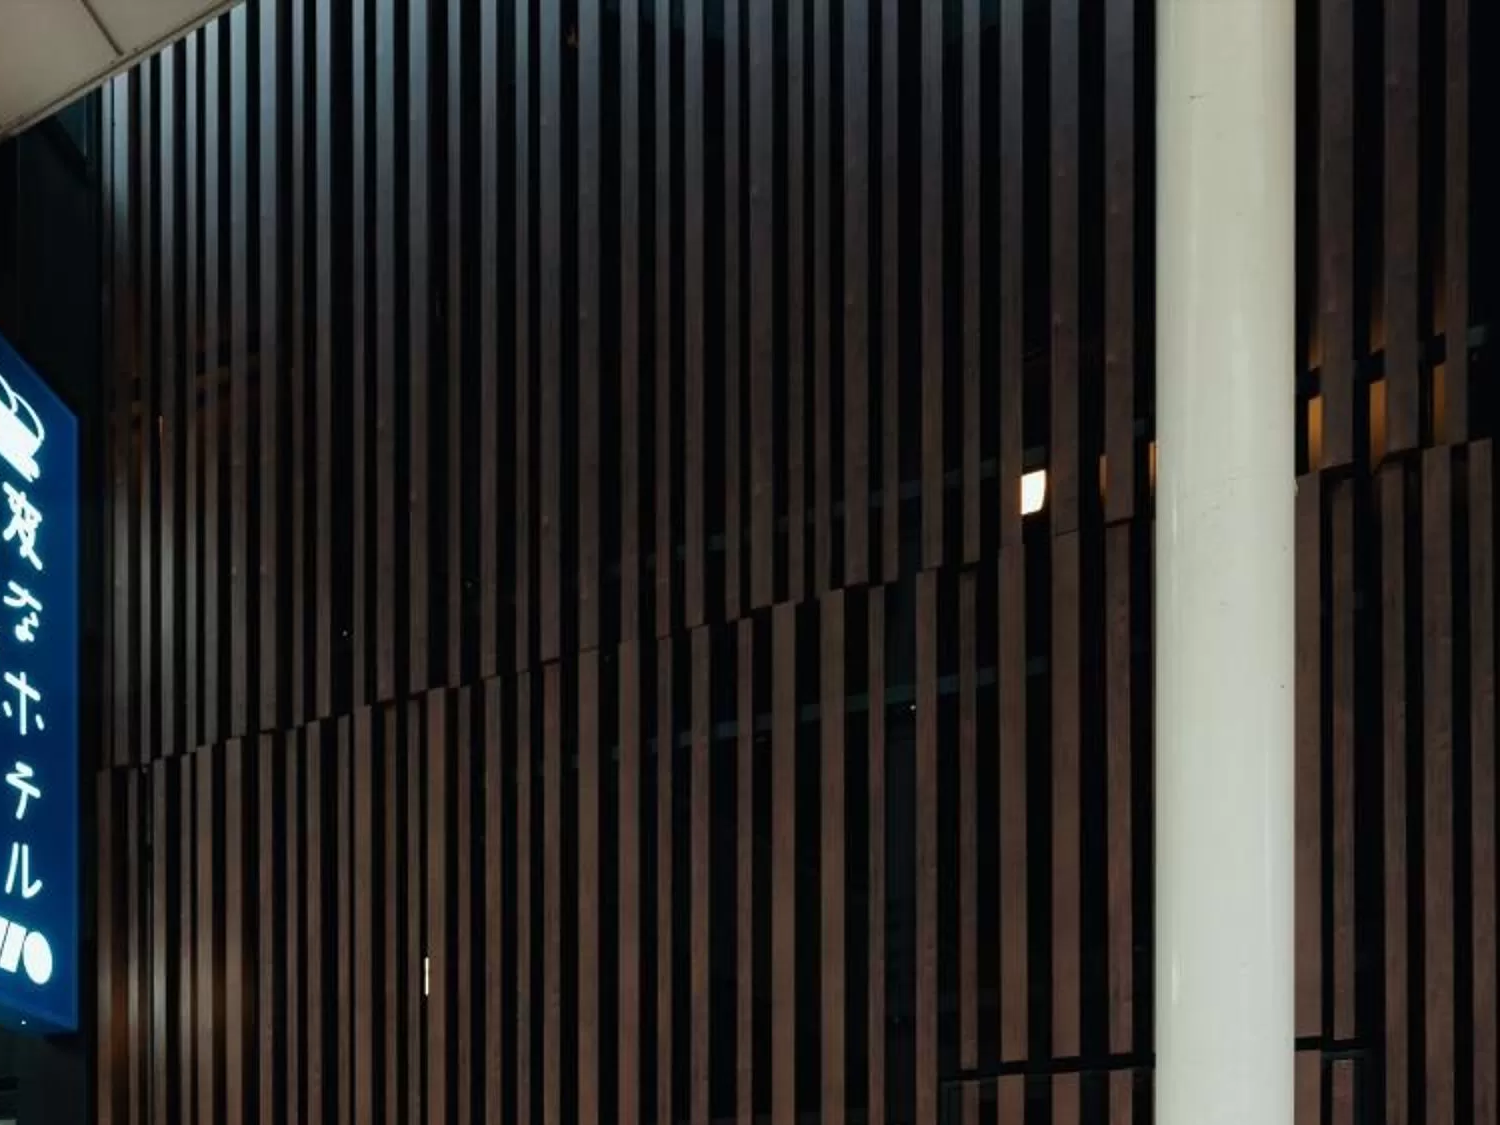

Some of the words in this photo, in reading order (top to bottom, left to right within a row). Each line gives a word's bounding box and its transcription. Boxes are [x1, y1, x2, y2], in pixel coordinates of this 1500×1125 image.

[3, 480, 44, 900] 変なホテル
